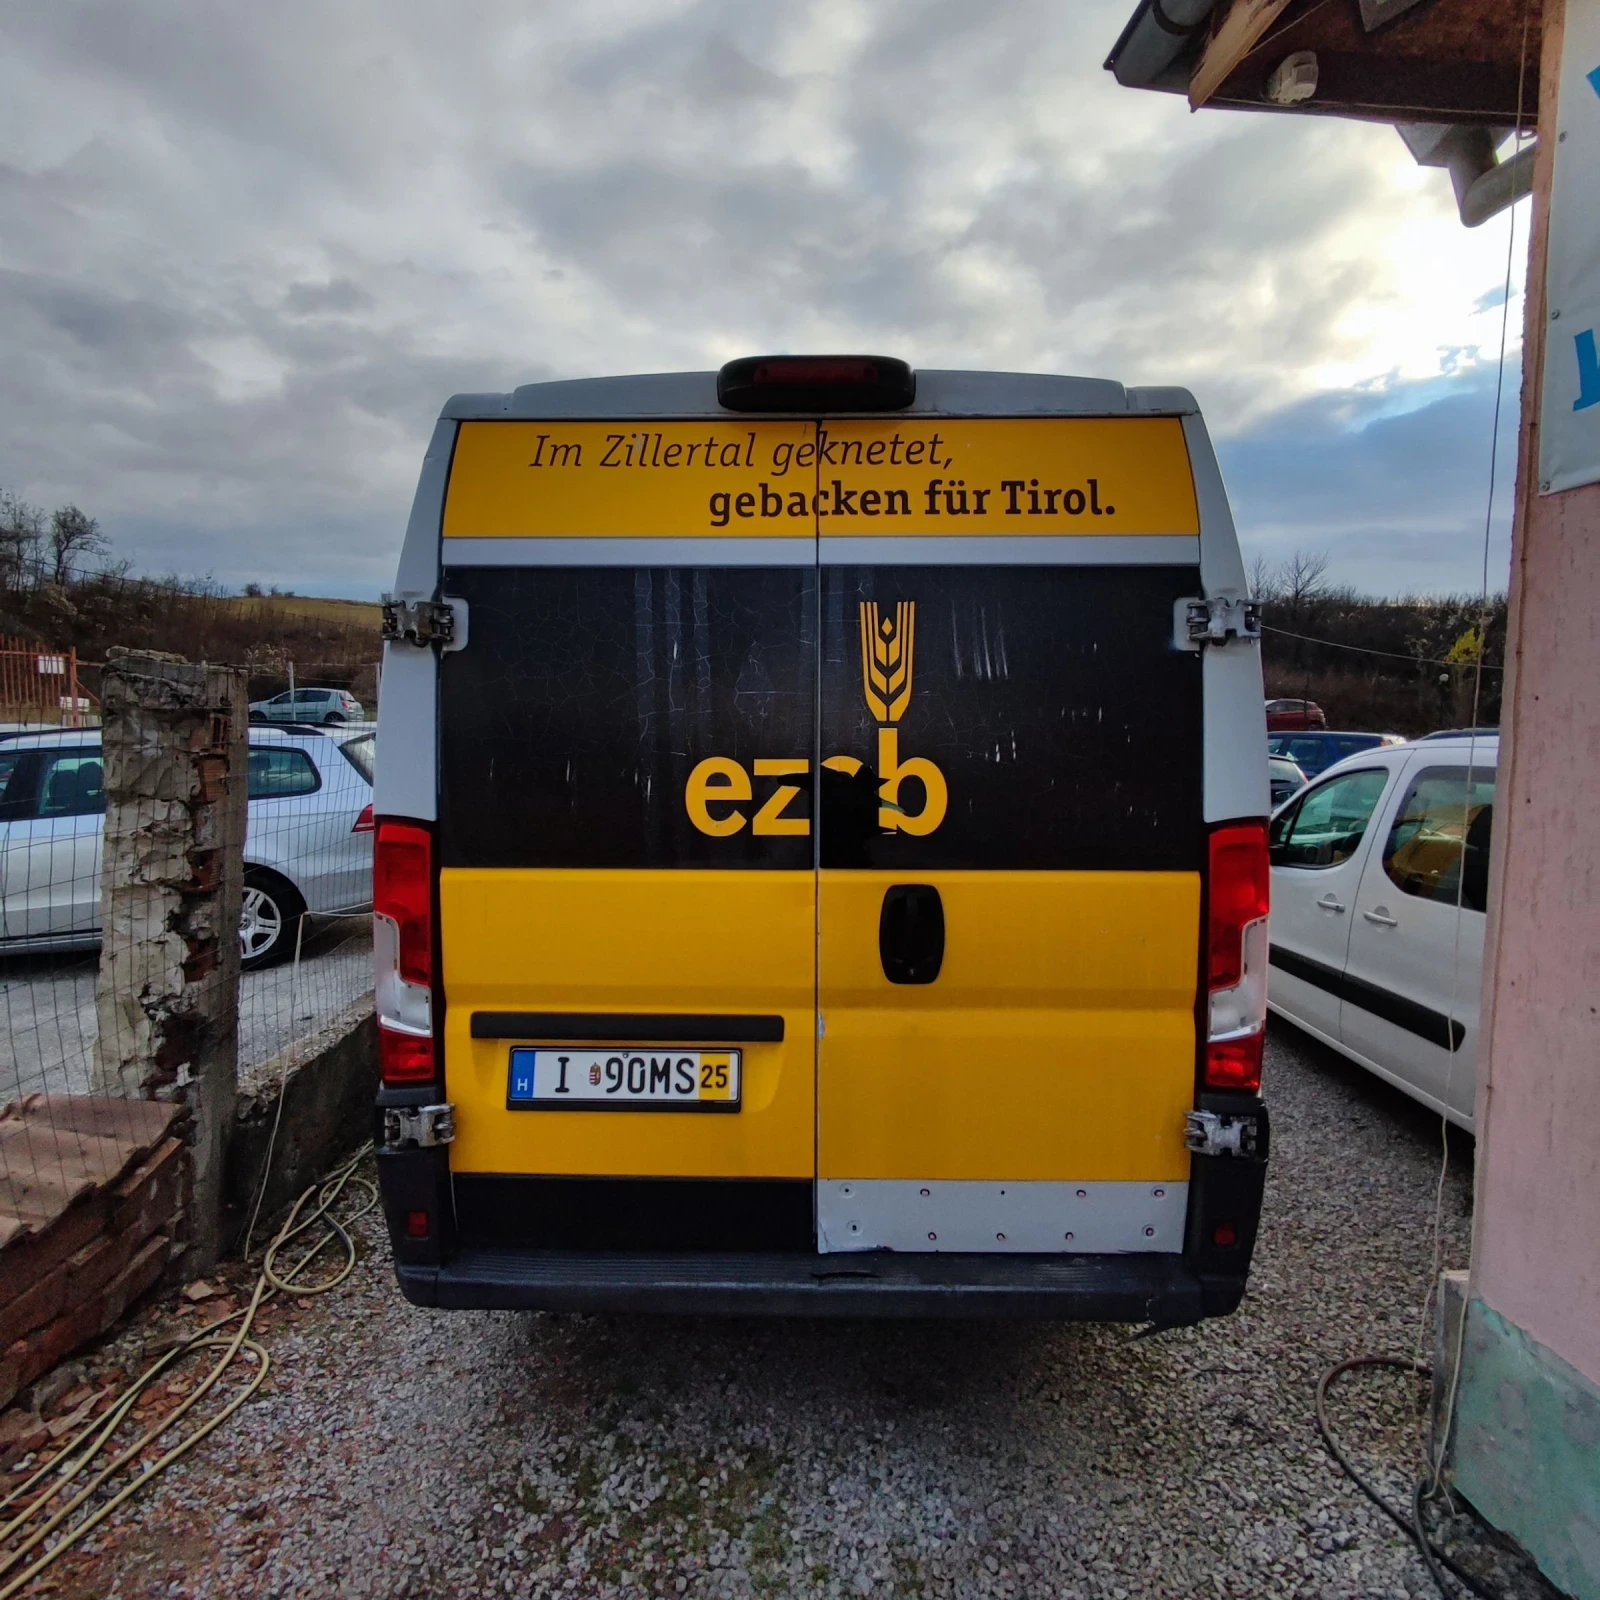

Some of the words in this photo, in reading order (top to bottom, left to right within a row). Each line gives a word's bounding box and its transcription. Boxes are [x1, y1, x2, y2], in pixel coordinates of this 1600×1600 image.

[529, 434, 582, 467] Im
[599, 433, 757, 468] Zillertal
[770, 430, 953, 477] geknetet,
[709, 480, 912, 527] gebacken
[924, 479, 991, 515] für
[1001, 478, 1116, 516] Tirol.
[517, 1078, 528, 1091] H
[701, 1065, 728, 1088] 25
